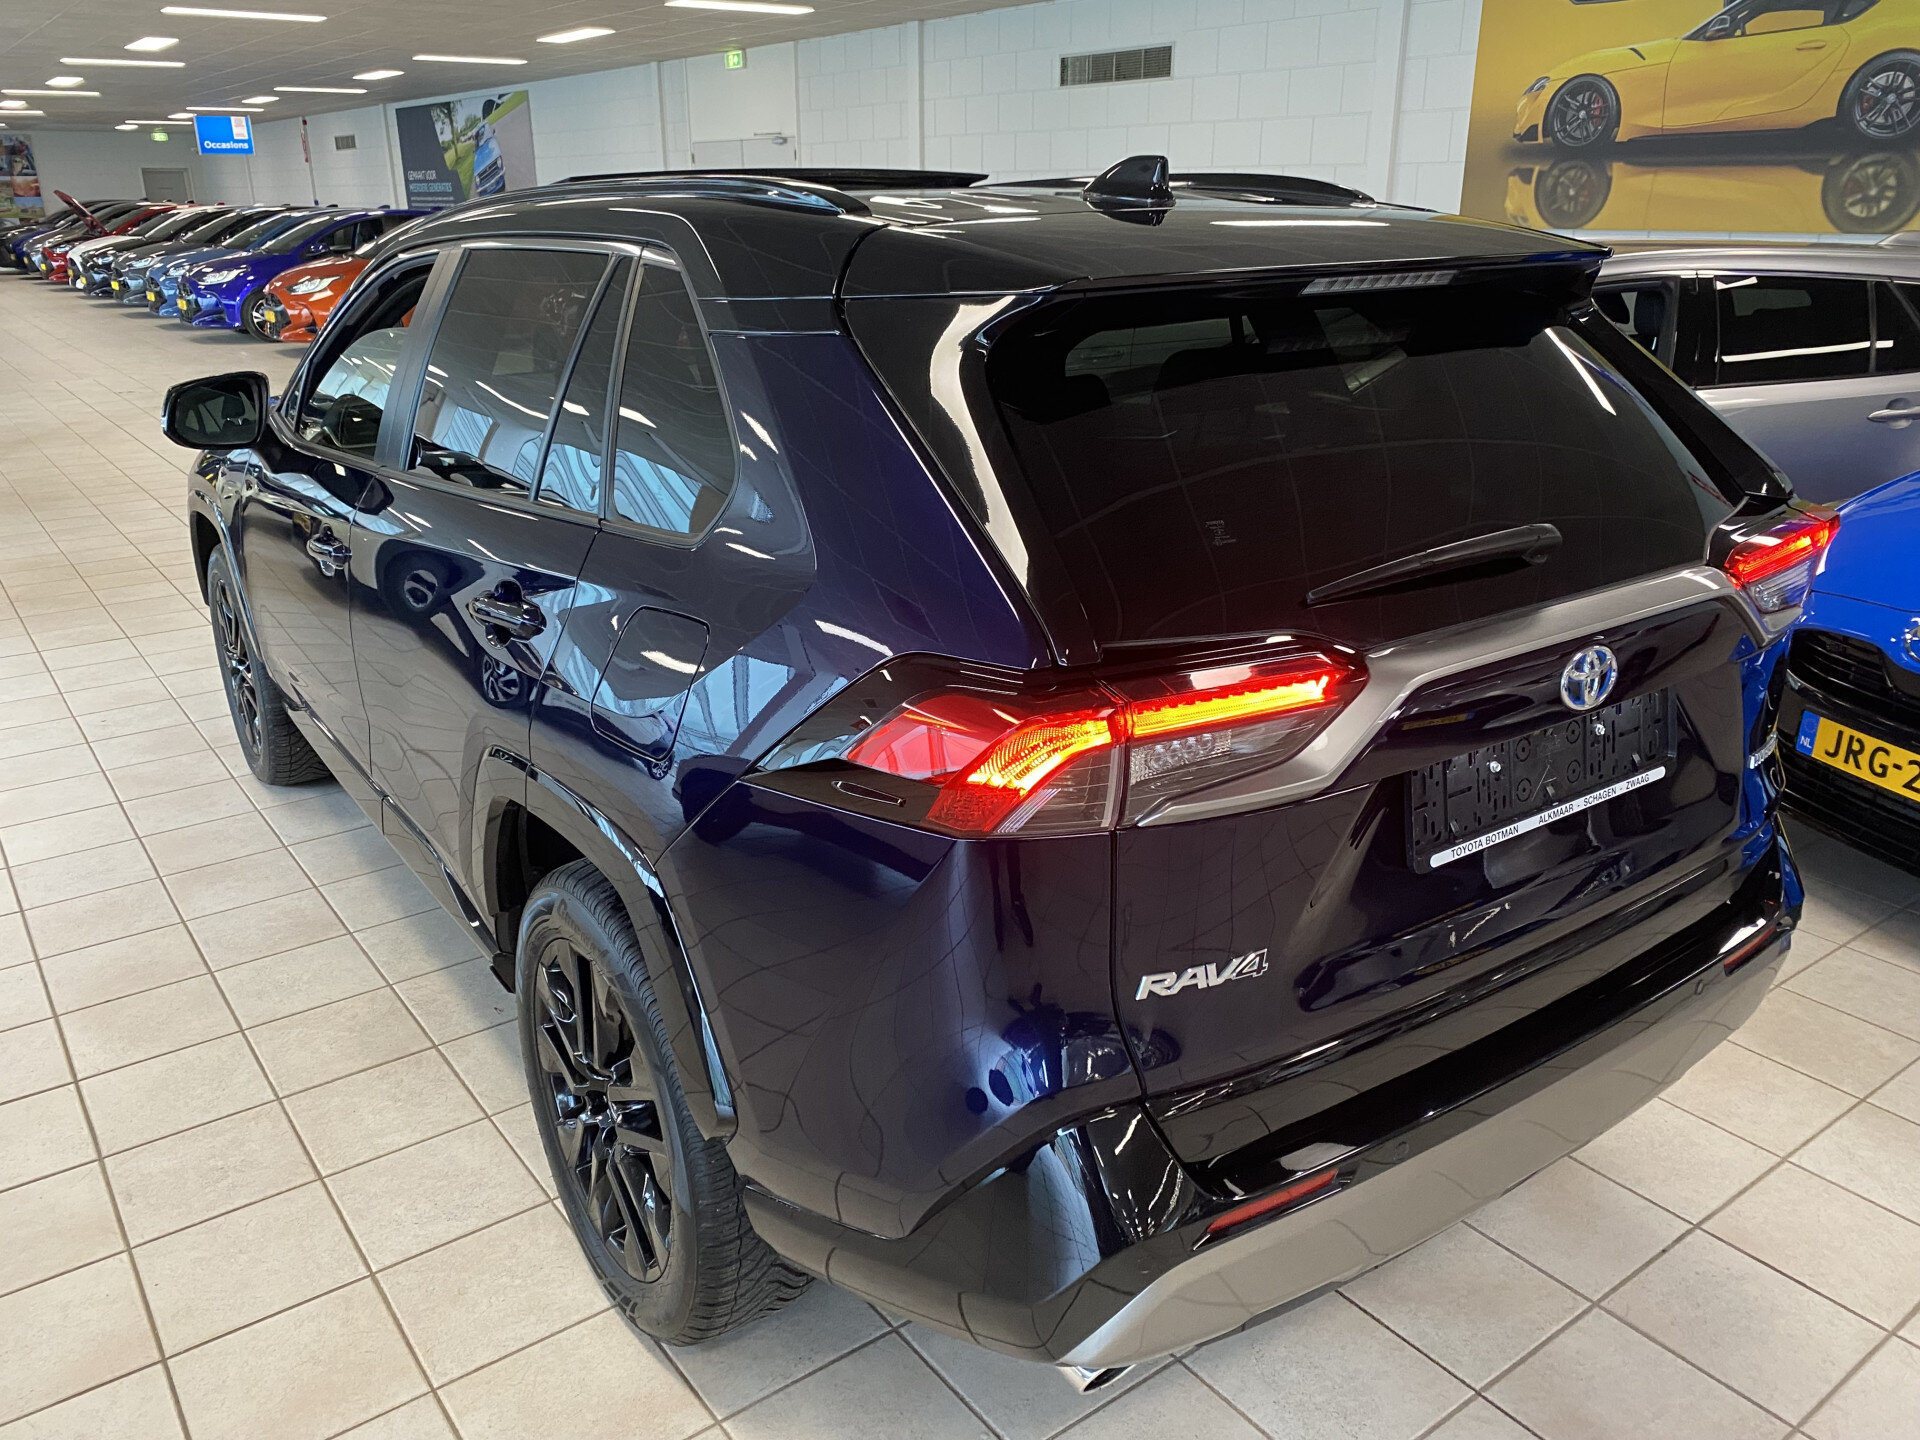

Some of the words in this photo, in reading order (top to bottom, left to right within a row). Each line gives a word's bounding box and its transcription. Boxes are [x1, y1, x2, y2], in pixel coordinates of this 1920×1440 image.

[204, 140, 249, 149] Occasions
[1800, 736, 1812, 749] NL
[1824, 729, 1920, 795] JRG-2
[1450, 839, 1484, 859] TOYOTA
[1485, 824, 1519, 846] BOTMAN
[1538, 803, 1574, 825] ALKMAAR
[1583, 787, 1617, 807] SCHAGEN
[1626, 773, 1650, 791] ZWAAG
[1135, 948, 1269, 1001] RAV4
